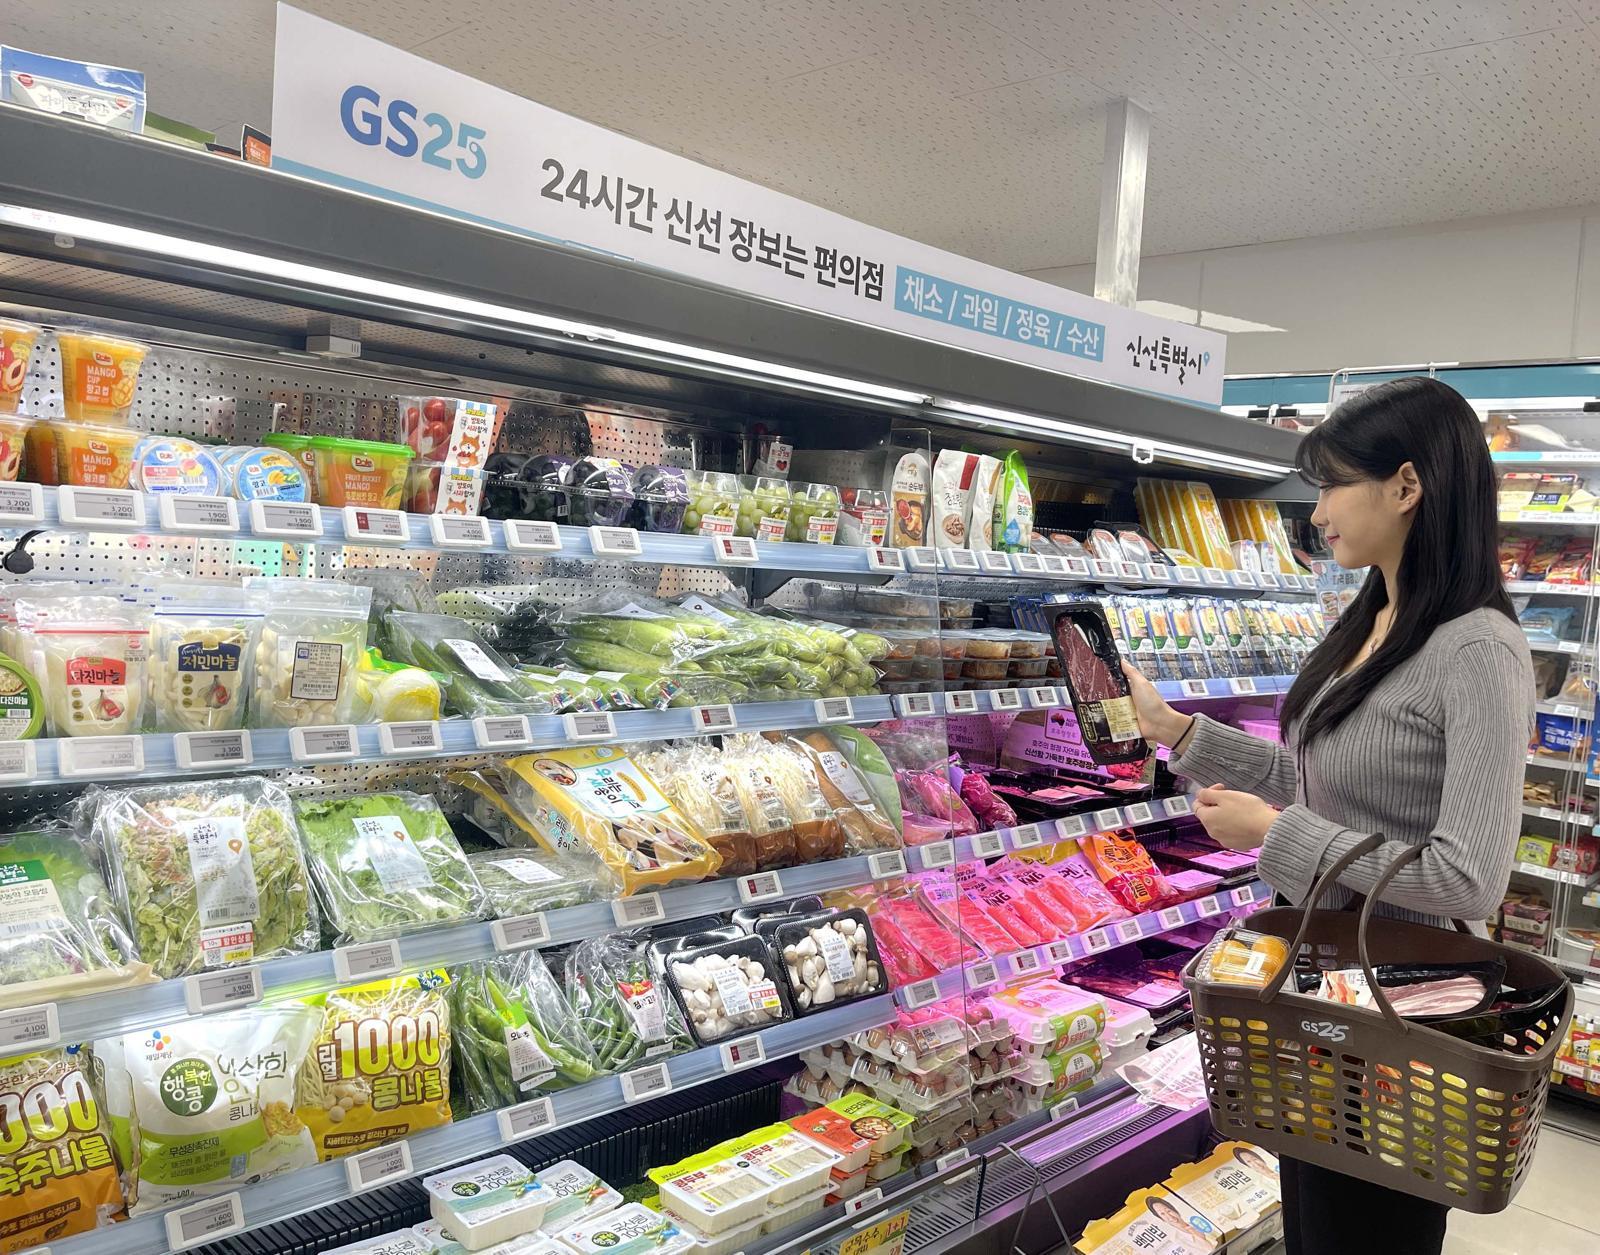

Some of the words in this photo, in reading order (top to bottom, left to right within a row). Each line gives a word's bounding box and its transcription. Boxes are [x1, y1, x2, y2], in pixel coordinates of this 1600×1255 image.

[340, 84, 487, 180] GS25
[541, 158, 658, 234] 24시간
[664, 197, 722, 255] 신선
[729, 216, 808, 279] 장보는
[814, 245, 884, 302] 편의점
[903, 275, 943, 314] 채소
[961, 294, 998, 331] 과일
[1016, 308, 1051, 345] 정육
[1066, 324, 1099, 358] 수산
[1126, 335, 1203, 386] 신선특별시
[86, 365, 117, 378] MANGO
[86, 375, 101, 384] CUP
[82, 454, 112, 465] MANGO
[83, 464, 97, 473] CUP
[355, 457, 373, 468] Dole
[345, 481, 370, 491] MANGO
[182, 654, 238, 670] 저민마늘
[1301, 1020, 1351, 1043] GS25
[332, 1010, 442, 1079] 1000
[371, 1066, 444, 1112] 콩나물
